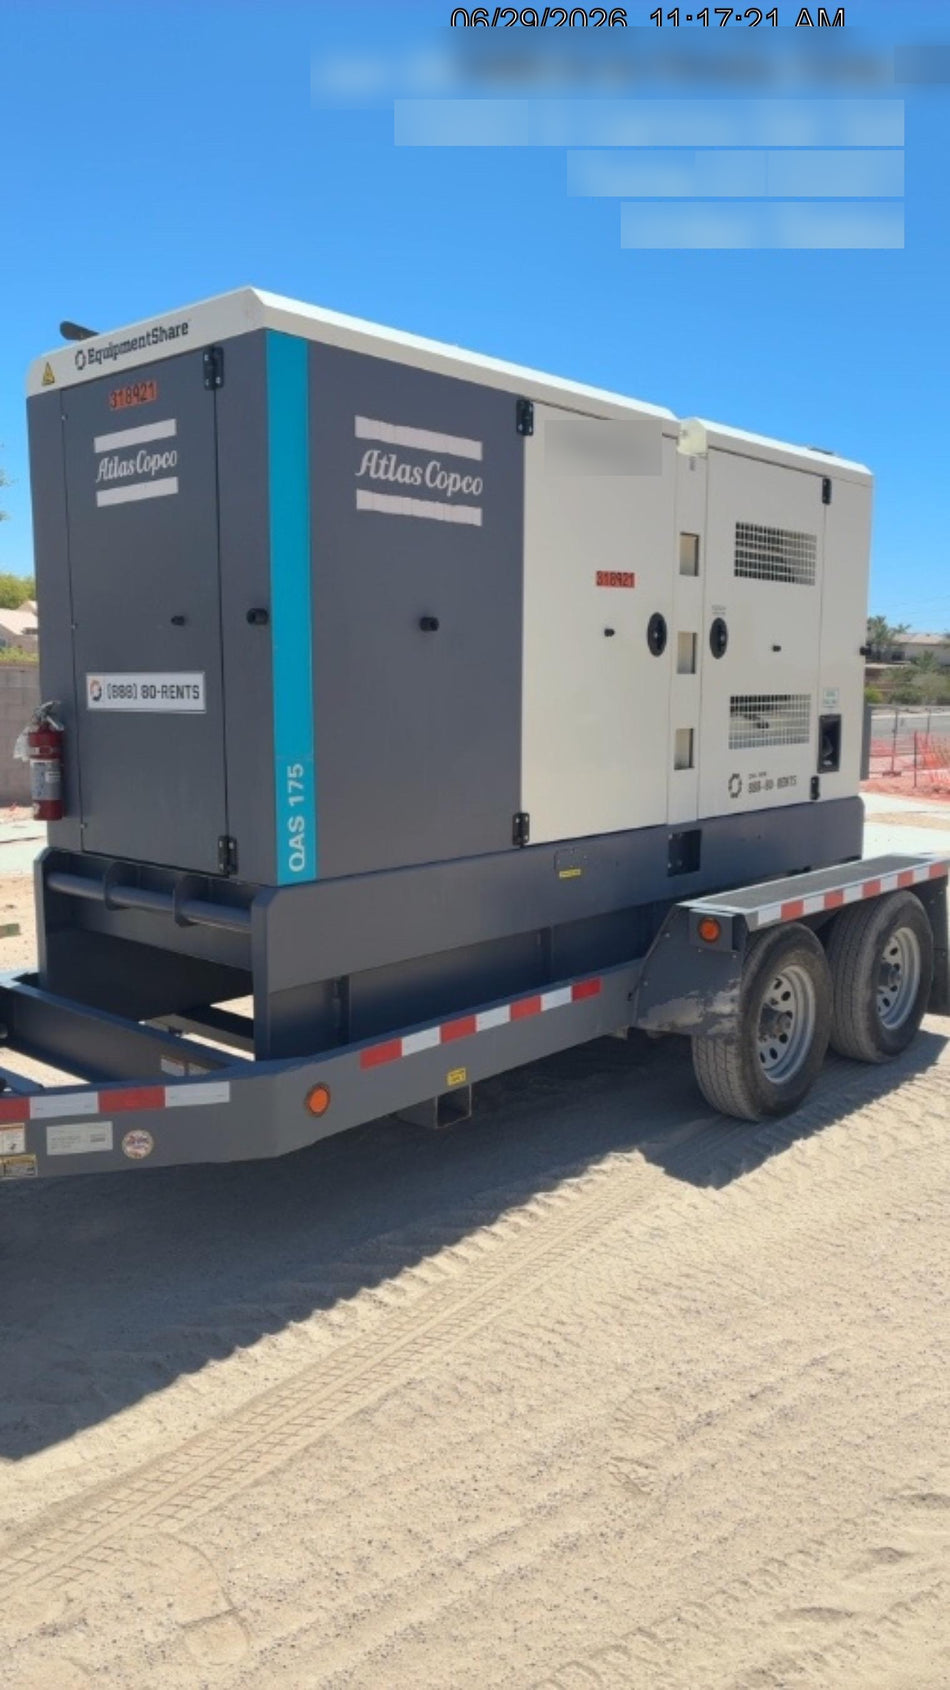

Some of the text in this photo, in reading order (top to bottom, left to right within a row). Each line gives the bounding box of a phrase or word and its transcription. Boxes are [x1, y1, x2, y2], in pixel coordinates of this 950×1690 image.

[88, 322, 190, 365] EquipmentShare
[109, 383, 157, 408] 318921
[96, 449, 178, 482] Atlas Copco
[355, 449, 484, 497] Atlas Copco
[107, 683, 138, 701] (888)
[287, 763, 306, 873] QAS 175
